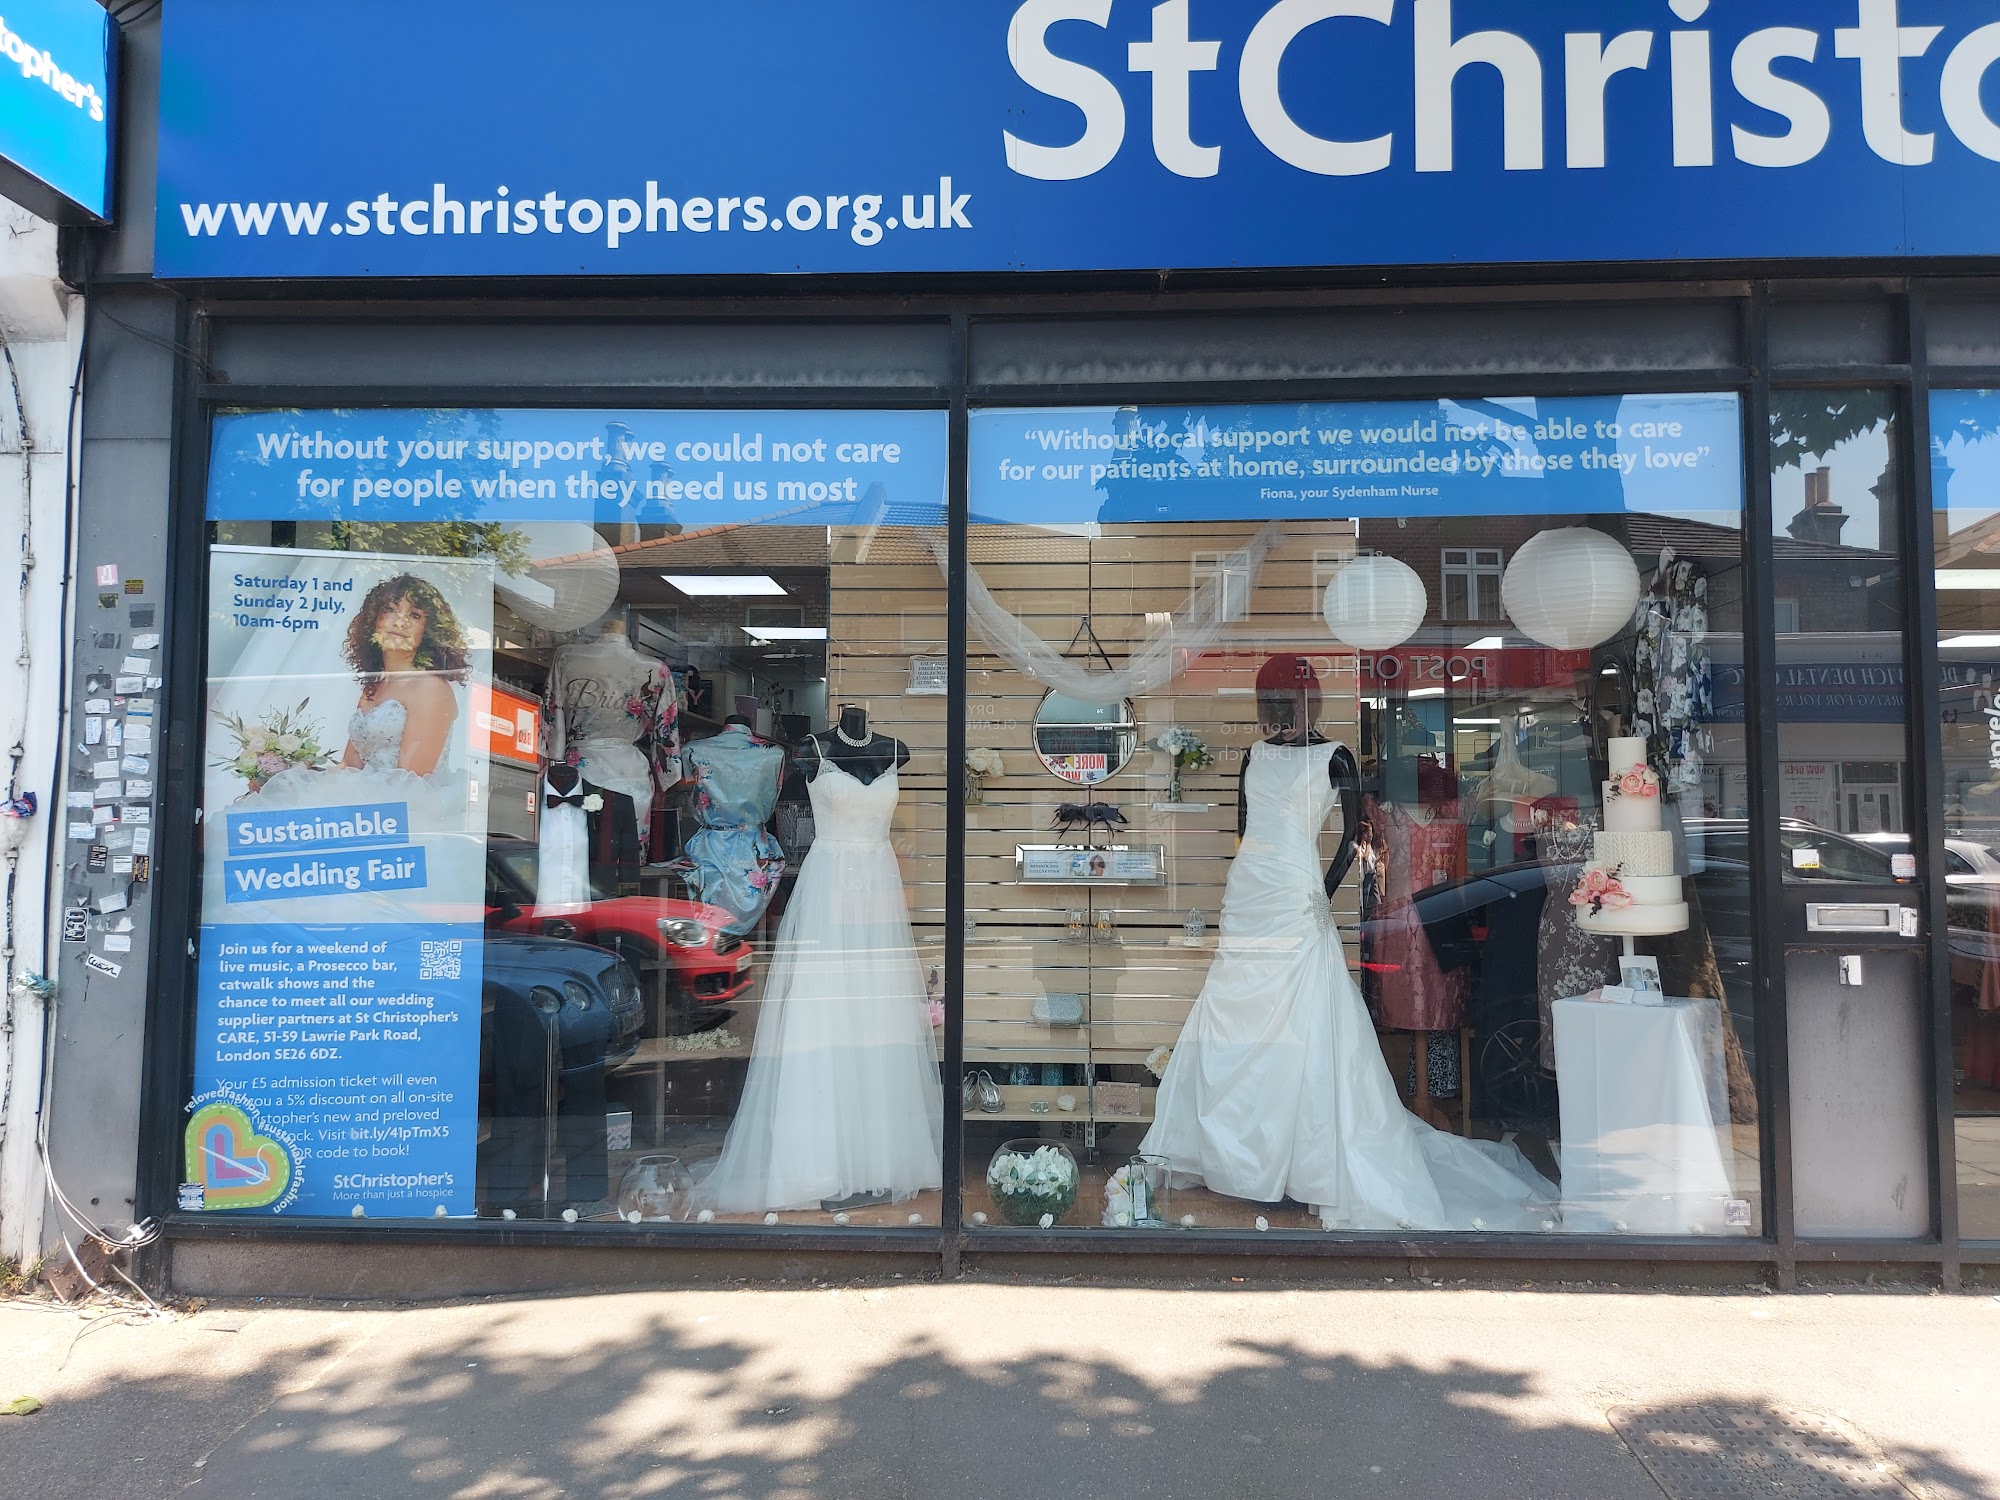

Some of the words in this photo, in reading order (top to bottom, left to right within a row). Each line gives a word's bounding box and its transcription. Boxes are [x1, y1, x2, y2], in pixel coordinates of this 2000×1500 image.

[181, 176, 973, 249] www.stchristophers.org.uk
[1146, 422, 1205, 449] local
[1211, 421, 1309, 450] support
[1318, 426, 1352, 446] we
[1360, 419, 1438, 445] would
[1445, 421, 1489, 444] not
[1495, 418, 1528, 442] be
[1534, 416, 1589, 441] able
[1594, 420, 1622, 439] to
[1629, 420, 1682, 439] care
[257, 431, 388, 462] Without
[396, 439, 468, 467] your
[478, 434, 611, 469] support,
[623, 442, 667, 463] we
[675, 432, 762, 463] could
[771, 438, 826, 464] not
[835, 442, 901, 463] care
[1000, 456, 1036, 480] for
[1042, 461, 1085, 480] our
[1090, 452, 1191, 484] patients
[1196, 456, 1221, 476] at
[1228, 454, 1304, 480] home,
[1311, 450, 1458, 476] surrounded
[1464, 449, 1499, 478] by
[1502, 448, 1574, 472] those
[1580, 446, 1638, 475] they
[297, 469, 345, 499] for
[353, 471, 461, 506] people
[472, 471, 555, 500] when
[565, 472, 637, 508] they
[645, 472, 723, 501] need
[733, 478, 768, 502] us
[777, 476, 857, 502] most
[1260, 487, 1298, 501] Fiona,
[1301, 489, 1329, 502] your
[1332, 485, 1397, 501] Sydenham
[1401, 484, 1439, 498] Nurse
[234, 574, 308, 593] Saturday
[313, 578, 319, 590] 1
[323, 578, 353, 591] and
[233, 594, 293, 613] Sunday
[299, 596, 308, 610] 2
[312, 597, 346, 614] July,
[233, 613, 319, 632] 10am-6pm
[238, 811, 398, 845] Sustainable
[235, 862, 361, 892] Wedding
[368, 856, 416, 882] Fair
[218, 943, 248, 957] Join
[251, 945, 267, 955] us
[271, 942, 292, 954] for
[296, 944, 304, 954] a
[306, 942, 369, 954] weekend
[372, 941, 388, 953] of
[220, 961, 245, 972] live
[249, 960, 293, 973] music,
[297, 963, 305, 972] a
[308, 960, 369, 972] Prosecco
[372, 959, 398, 972] bar,
[219, 978, 274, 991] catwalk
[277, 979, 319, 989] shows
[323, 978, 349, 989] and
[352, 978, 376, 988] the
[218, 996, 268, 1009] chance
[272, 997, 287, 1008] to
[291, 996, 326, 1007] meet
[329, 995, 346, 1006] all
[350, 996, 373, 1006] our
[377, 994, 434, 1008] wedding
[218, 1014, 274, 1029] supplier
[278, 1013, 335, 1027] partners
[339, 1014, 352, 1024] at
[355, 1013, 370, 1023] St
[217, 1032, 260, 1045] CARE,
[264, 1031, 298, 1043] 51-59
[302, 1030, 346, 1042] Lawrie
[350, 1029, 380, 1041] Park
[384, 1029, 422, 1042] Road,
[216, 1050, 271, 1062] London
[274, 1049, 307, 1060] SE26
[310, 1048, 342, 1060] 6DZ.
[216, 1078, 248, 1090] Your
[251, 1078, 267, 1088] £5
[271, 1076, 336, 1088] admission
[340, 1075, 377, 1086] ticket
[381, 1074, 403, 1086] will
[407, 1075, 437, 1085] even
[275, 1097, 283, 1106] a
[287, 1094, 305, 1106] 5%
[309, 1092, 366, 1105] discount
[370, 1093, 387, 1104] on
[391, 1091, 405, 1103] all
[408, 1092, 454, 1102] on-site
[324, 1112, 352, 1122] new
[355, 1110, 380, 1122] and
[383, 1109, 440, 1124] preloved
[318, 1130, 347, 1140] Visit
[317, 1146, 349, 1158] code
[353, 1146, 370, 1156] to
[372, 1144, 410, 1156] book!
[333, 1191, 360, 1200] More
[363, 1190, 385, 1199] than
[386, 1189, 405, 1200] just
[416, 1188, 454, 1198] hospice
